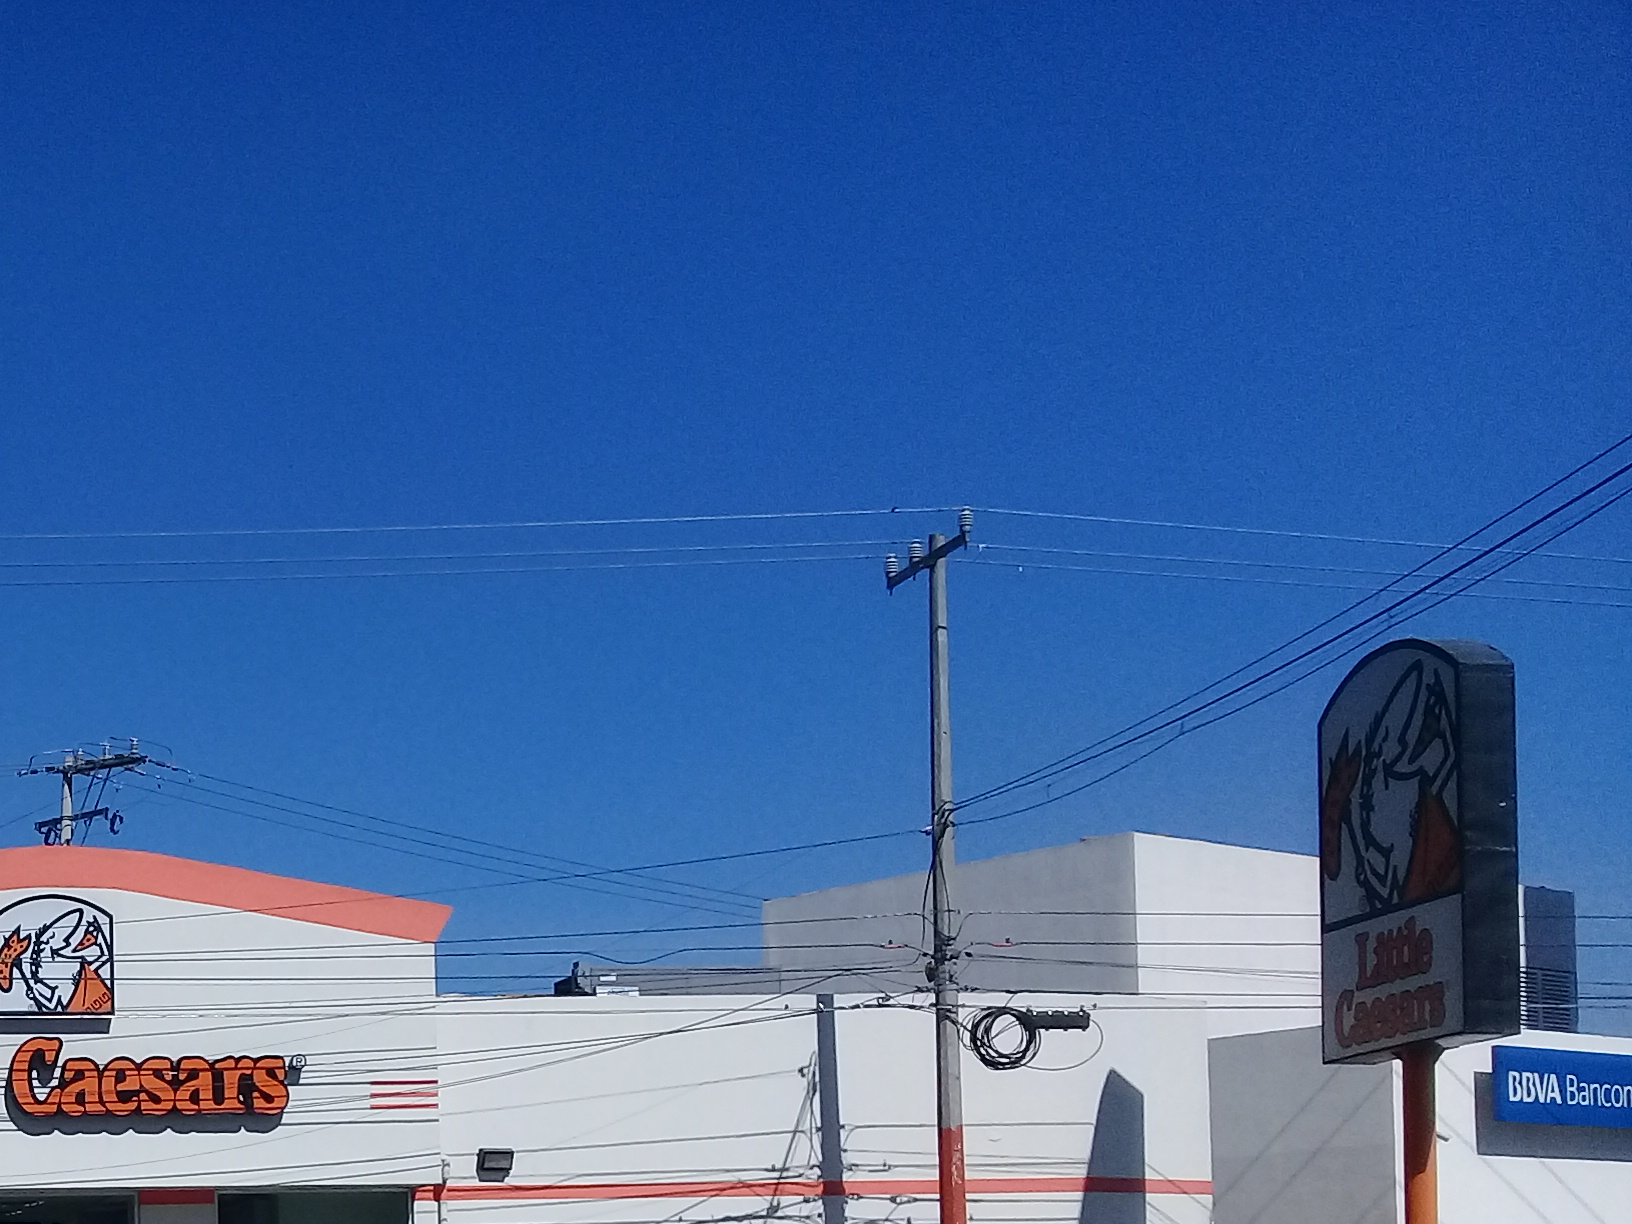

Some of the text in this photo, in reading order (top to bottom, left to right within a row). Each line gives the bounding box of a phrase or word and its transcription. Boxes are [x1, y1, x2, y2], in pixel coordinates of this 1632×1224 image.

[1354, 916, 1434, 988] Little
[1334, 980, 1446, 1051] Caesars
[9, 1036, 290, 1120] Caesars
[1507, 1070, 1563, 1105] BBVA
